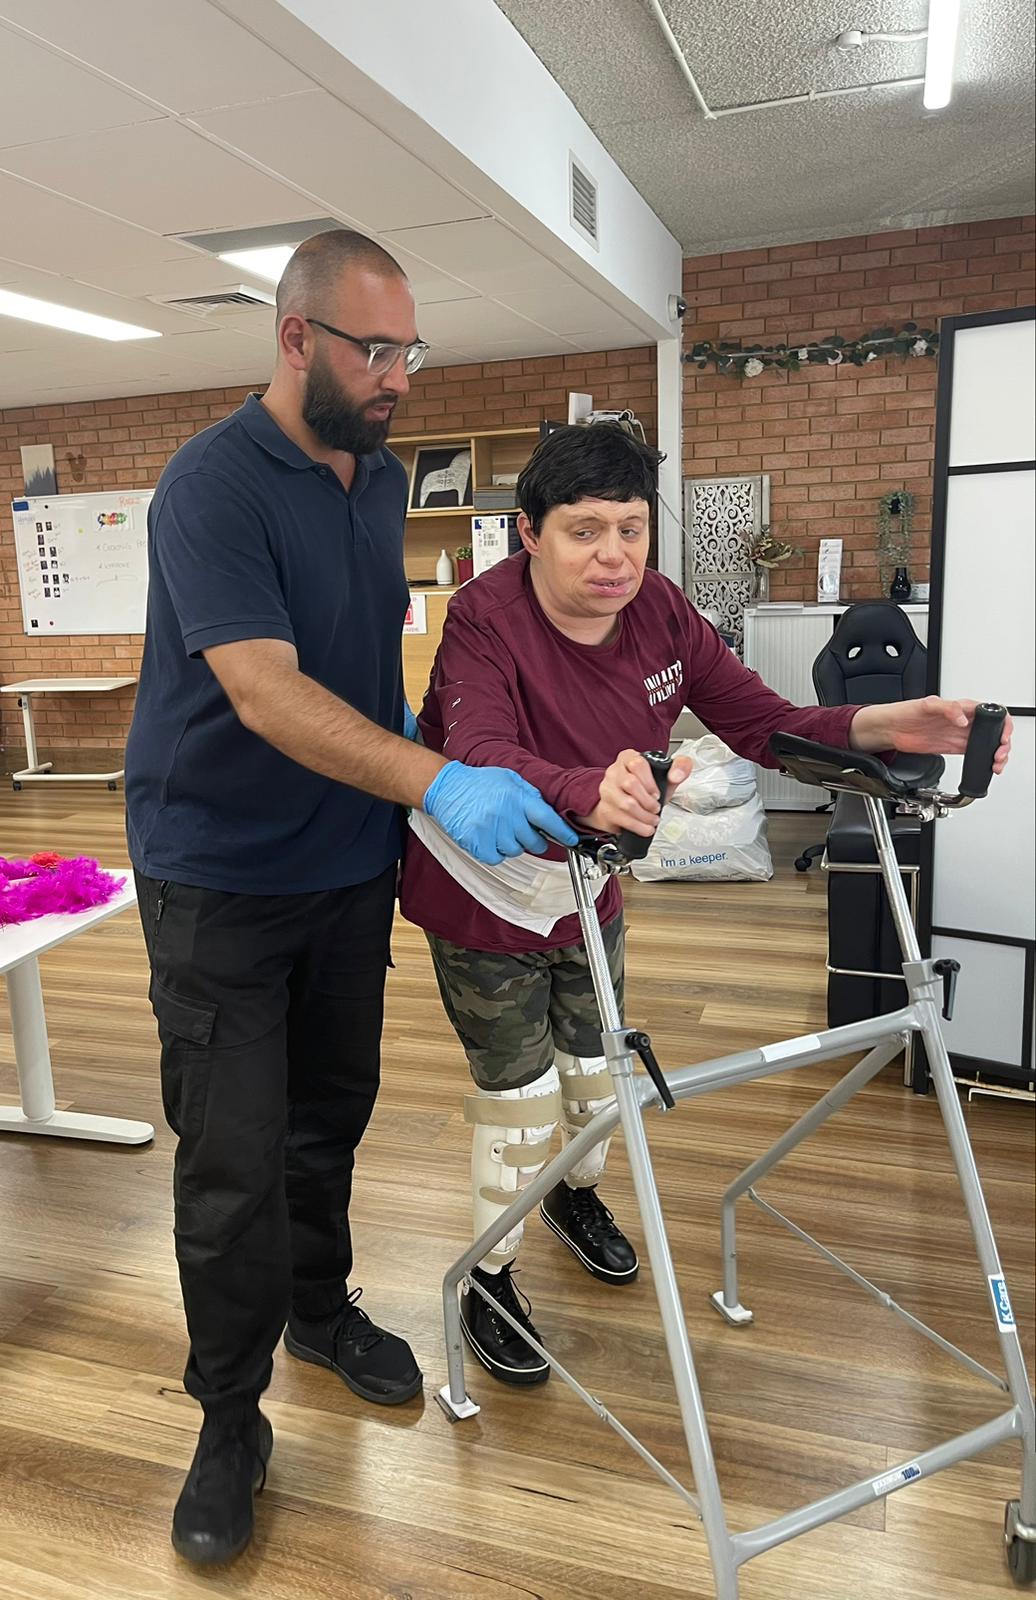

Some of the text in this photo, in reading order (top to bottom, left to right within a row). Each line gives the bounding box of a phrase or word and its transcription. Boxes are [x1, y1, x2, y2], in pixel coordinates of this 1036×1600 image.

[660, 852, 728, 868] I'm a keeper.
